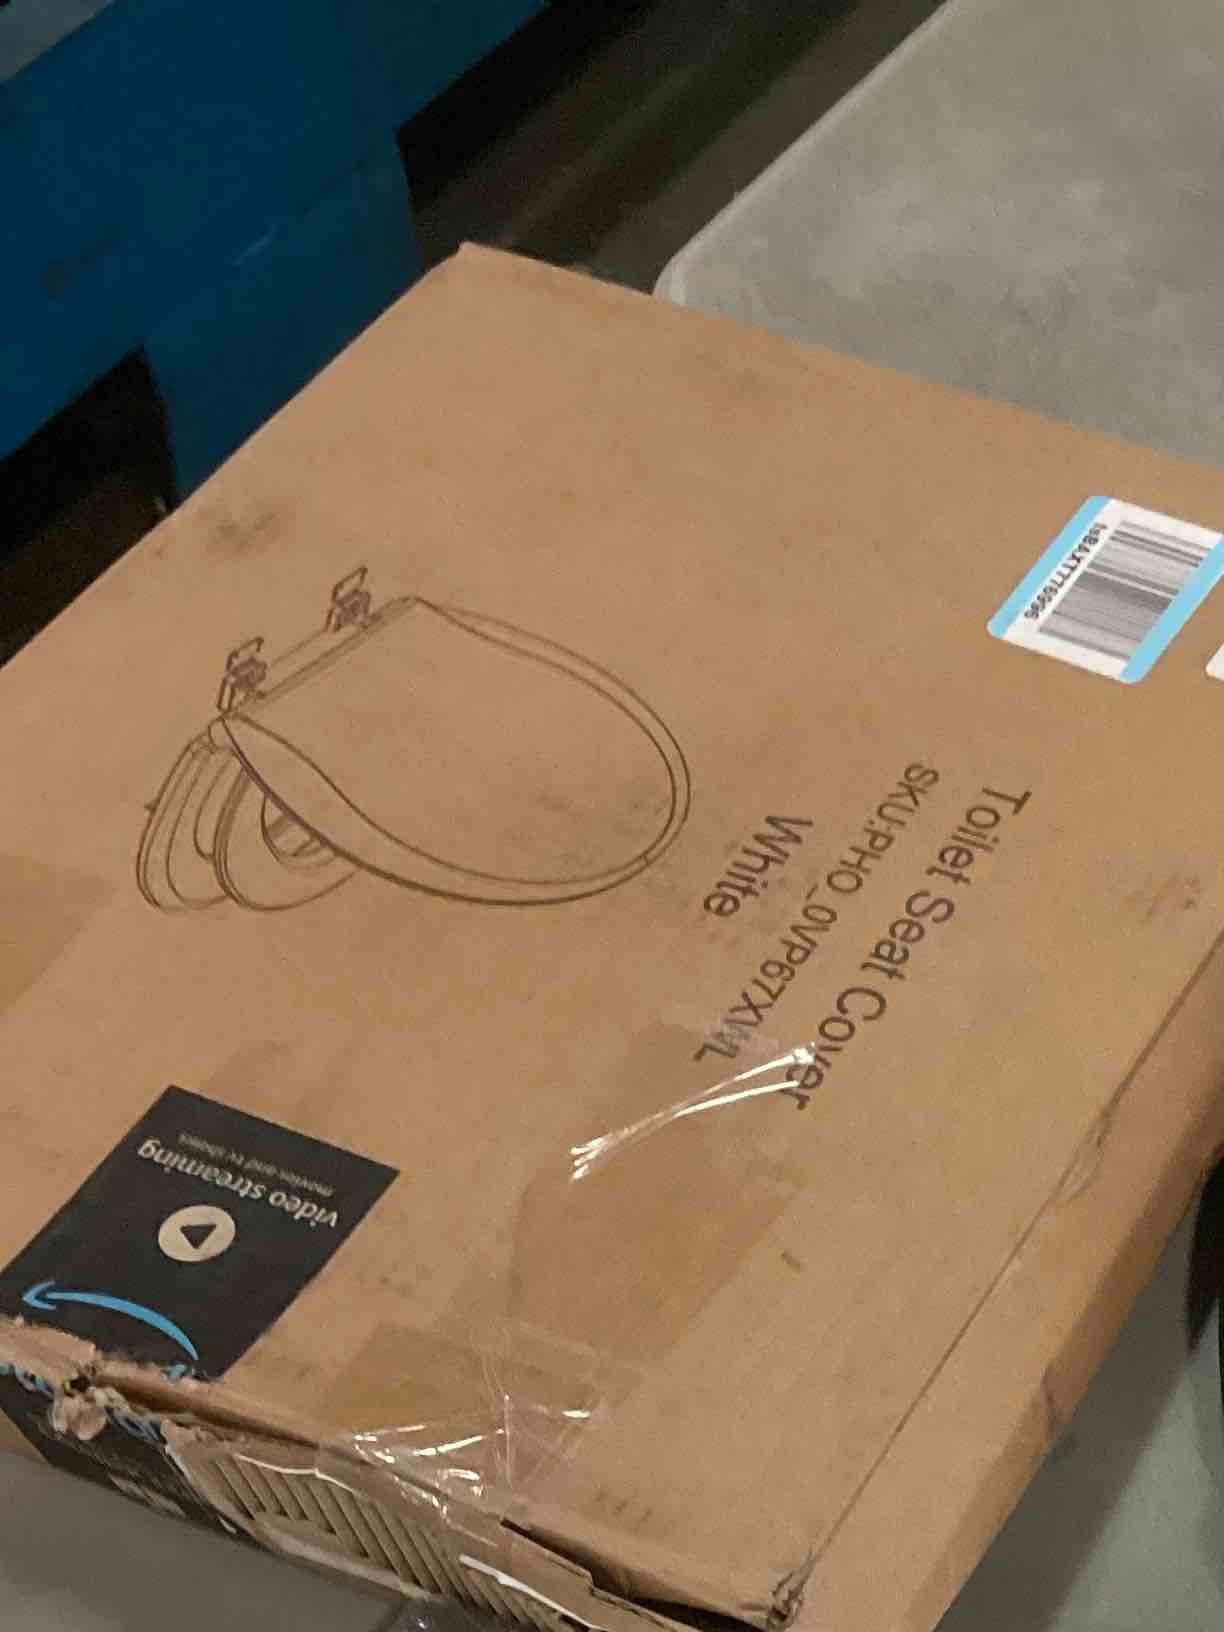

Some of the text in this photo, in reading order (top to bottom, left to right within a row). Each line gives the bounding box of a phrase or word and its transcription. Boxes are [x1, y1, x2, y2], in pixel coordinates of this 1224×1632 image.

[703, 815, 813, 916] White
[782, 786, 1031, 1110] Toilet Seat Cover
[137, 1138, 339, 1229] video streaming
